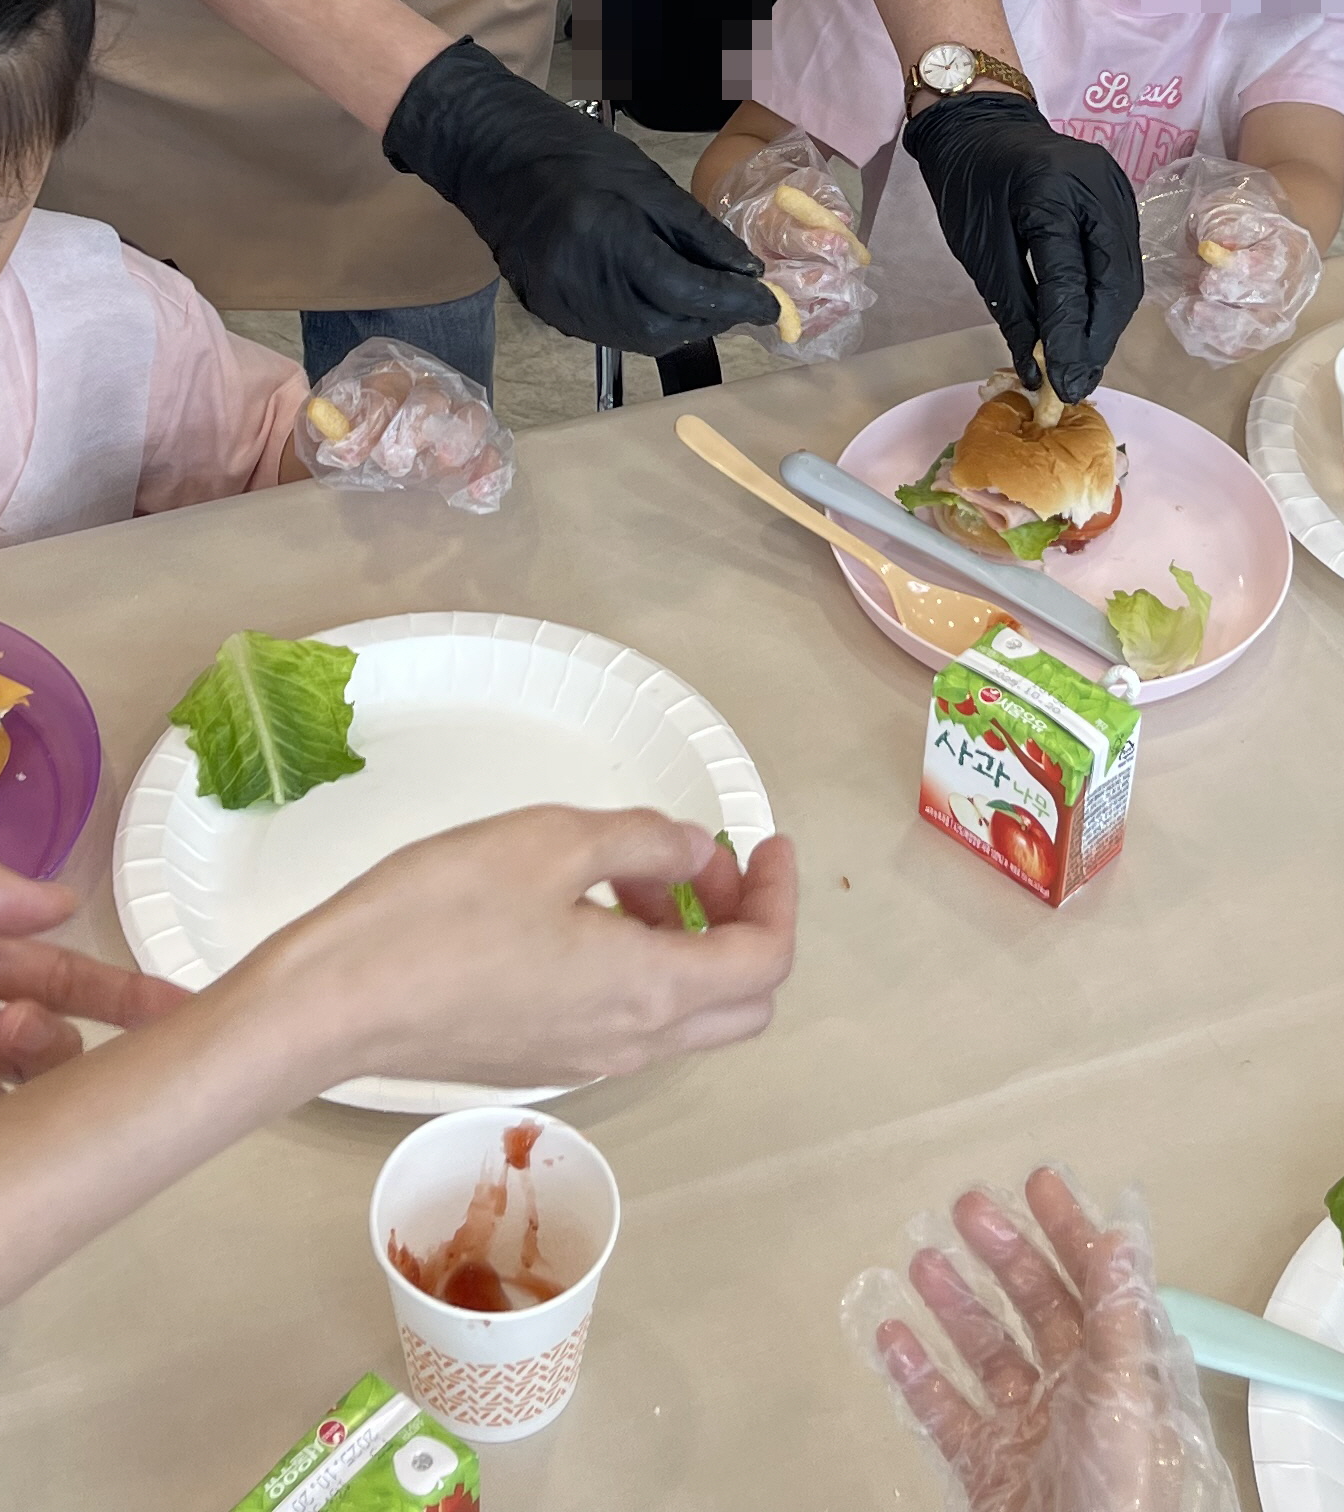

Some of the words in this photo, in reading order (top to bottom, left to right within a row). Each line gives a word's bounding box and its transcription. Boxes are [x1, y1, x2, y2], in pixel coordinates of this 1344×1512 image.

[1000, 698, 1048, 733] 서울우유
[934, 729, 1011, 788] 사과
[1012, 779, 1051, 818] 나무
